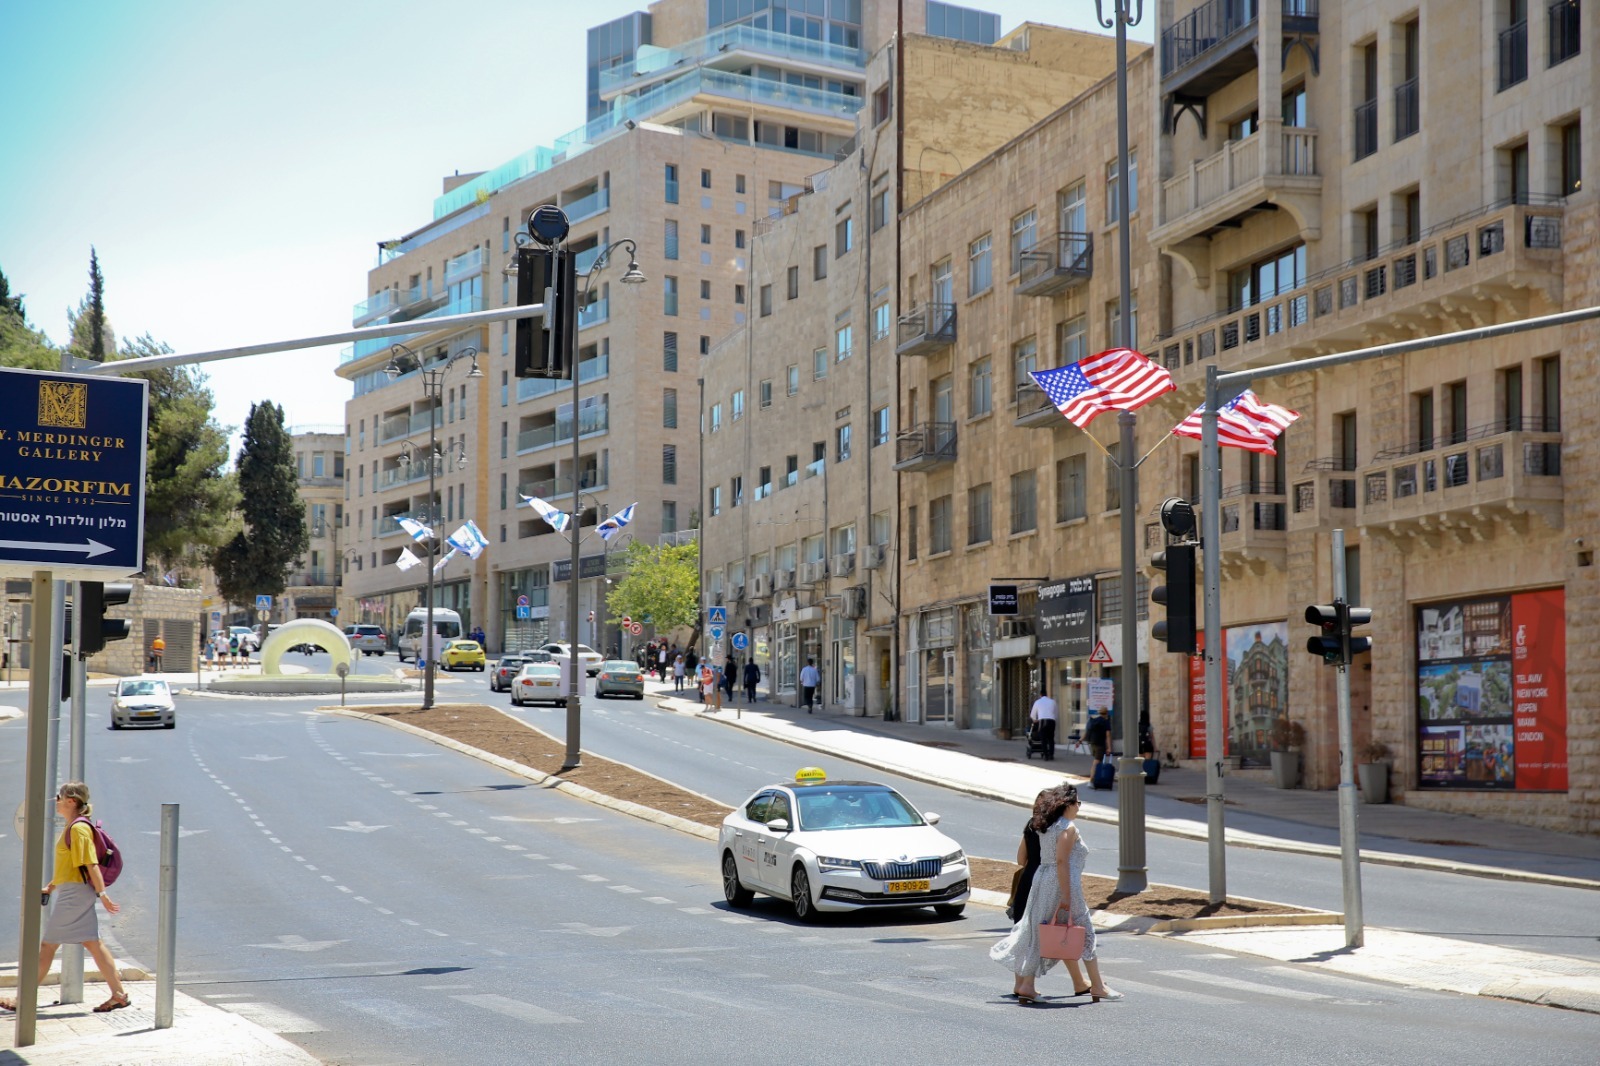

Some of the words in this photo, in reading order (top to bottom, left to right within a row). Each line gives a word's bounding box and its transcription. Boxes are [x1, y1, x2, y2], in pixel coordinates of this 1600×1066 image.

[17, 431, 125, 448] MERDINGER
[18, 446, 102, 462] GALLERY
[22, 494, 60, 503] SINCE
[67, 497, 95, 505] 1952
[45, 514, 94, 527] וולדורף
[98, 516, 127, 529] מלון
[1038, 583, 1066, 600] Synagogue
[1516, 688, 1531, 698] NEW
[1531, 687, 1549, 697] YORK
[1517, 702, 1537, 713] ASPEN
[1517, 731, 1544, 742] LONDON
